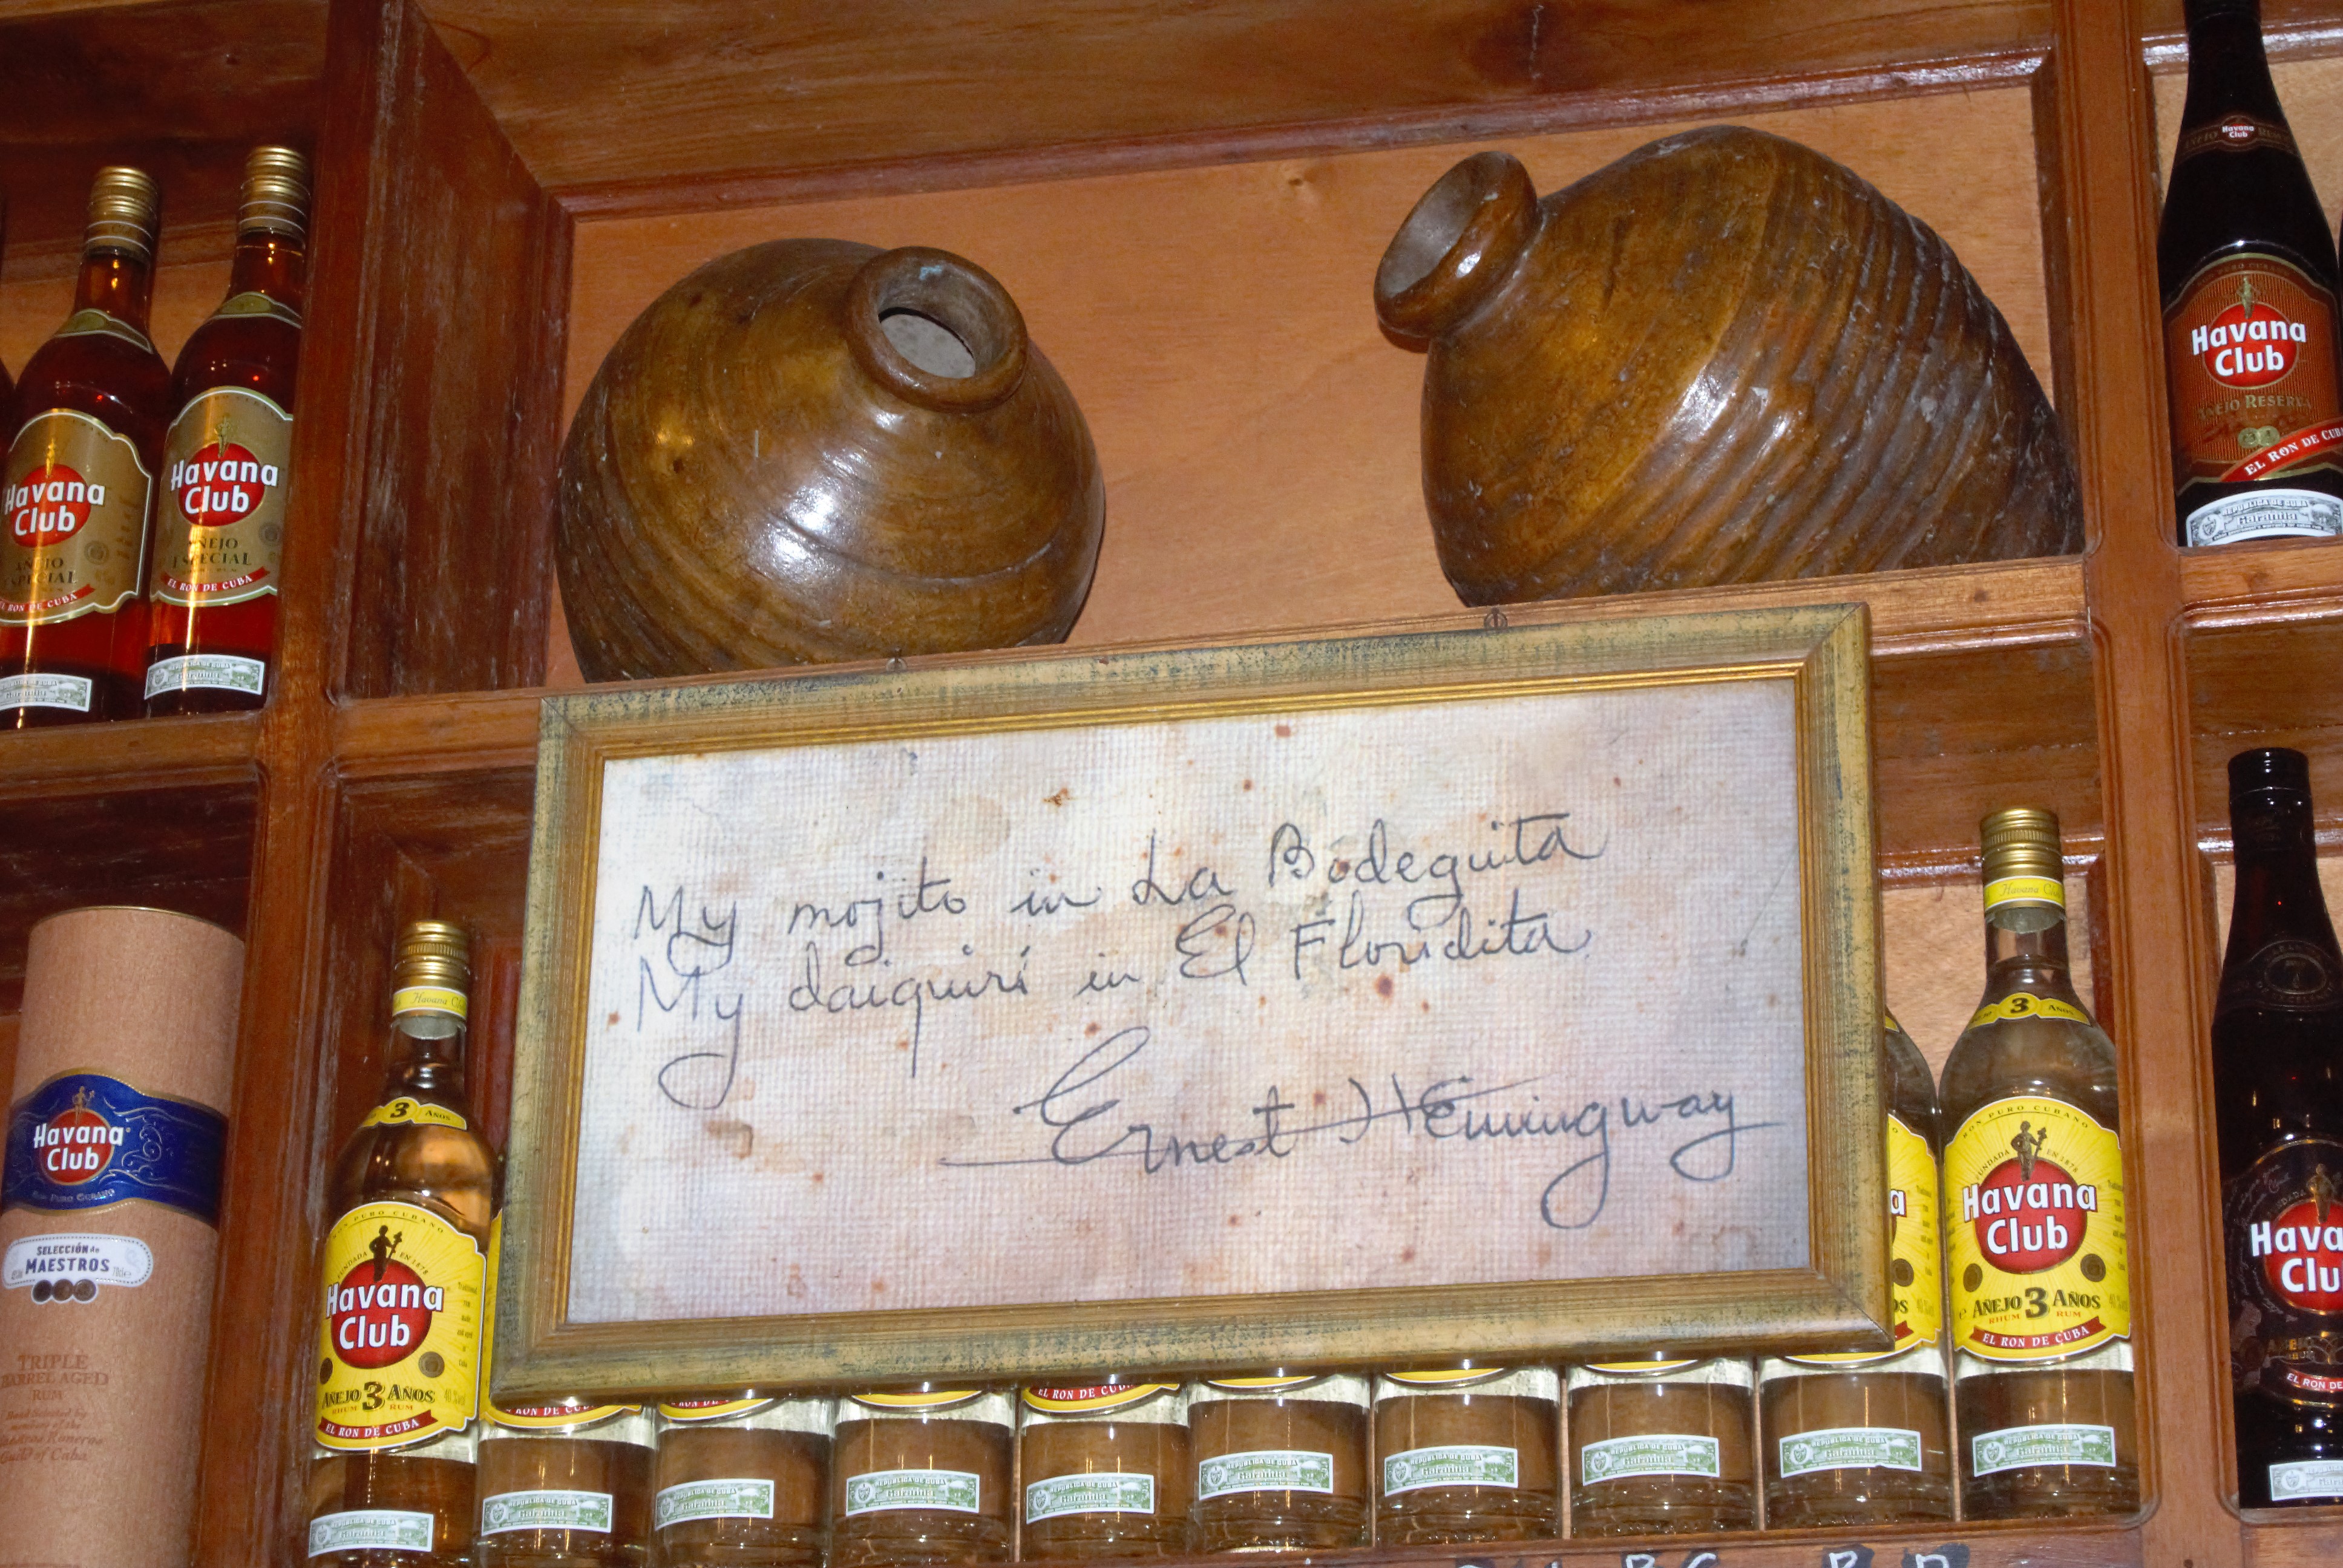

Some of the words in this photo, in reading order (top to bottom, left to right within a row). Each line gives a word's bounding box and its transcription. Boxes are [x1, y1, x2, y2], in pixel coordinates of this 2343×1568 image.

[2221, 125, 2255, 133] Havana
[2191, 320, 2307, 356] Havana
[2215, 344, 2285, 376] Club
[2244, 460, 2266, 476] EL
[2267, 442, 2299, 462] RON
[2301, 434, 2320, 448] DE
[171, 460, 279, 491] Havana
[4, 480, 106, 515] Havana
[185, 485, 250, 514] Club
[15, 505, 76, 536] Club
[168, 578, 177, 588] EL
[179, 583, 198, 592] RON
[203, 583, 218, 592] DE
[221, 575, 253, 590] CUBA
[47, 592, 78, 608] CUBA
[634, 884, 738, 978] My
[788, 856, 967, 967] mojito
[1010, 867, 1102, 916] in
[1132, 827, 1236, 906] La
[1268, 812, 1608, 932] Bodeguita
[637, 956, 743, 1110] My
[1175, 903, 1256, 986] El
[1291, 889, 1593, 981] Floridita
[2010, 998, 2030, 1014] 3
[390, 1102, 410, 1118] 3
[1988, 1106, 2025, 1119] PURO
[2033, 1106, 2089, 1129] CUBANO
[33, 1122, 125, 1149] Havana
[1013, 1025, 1295, 1175] Ernest
[1339, 1072, 1786, 1229] Hemingway
[47, 1146, 100, 1172] Club
[1962, 1181, 2098, 1223] Havana
[354, 1210, 385, 1221] PURO
[393, 1210, 444, 1234] CUBANO
[1987, 1214, 2069, 1255] Club
[36, 1242, 89, 1256] SELECCIÓN
[399, 1252, 411, 1261] EN
[25, 1257, 110, 1275] MAESTROS
[326, 1281, 445, 1319] Havana
[1973, 1294, 2023, 1319] AÑEJO
[2025, 1286, 2050, 1320] 3
[2053, 1289, 2102, 1310] AÑOS
[339, 1313, 411, 1350] Club
[1989, 1313, 2020, 1325] RHUM
[1982, 1333, 1996, 1346] EL
[2001, 1336, 2025, 1347] RON
[2032, 1336, 2050, 1347] DE
[2055, 1326, 2089, 1344] CUBA
[18, 1354, 89, 1371] TRIPLE
[1, 1372, 56, 1389] BARREL
[60, 1371, 110, 1385] AGED
[2287, 1372, 2299, 1383] EL
[2302, 1378, 2326, 1390] RON
[2329, 1381, 2343, 1390] DE
[323, 1388, 362, 1410] AÑEJO
[362, 1381, 385, 1412] 3
[388, 1383, 436, 1404] AÑOS
[1038, 1388, 1048, 1398] EL
[1052, 1388, 1073, 1399] RON
[1080, 1388, 1095, 1399] DE
[332, 1405, 358, 1415] RHUM
[325, 1425, 336, 1435] EL
[338, 1428, 359, 1437] RON
[365, 1427, 381, 1437] DE
[385, 1419, 420, 1435] CUBA
